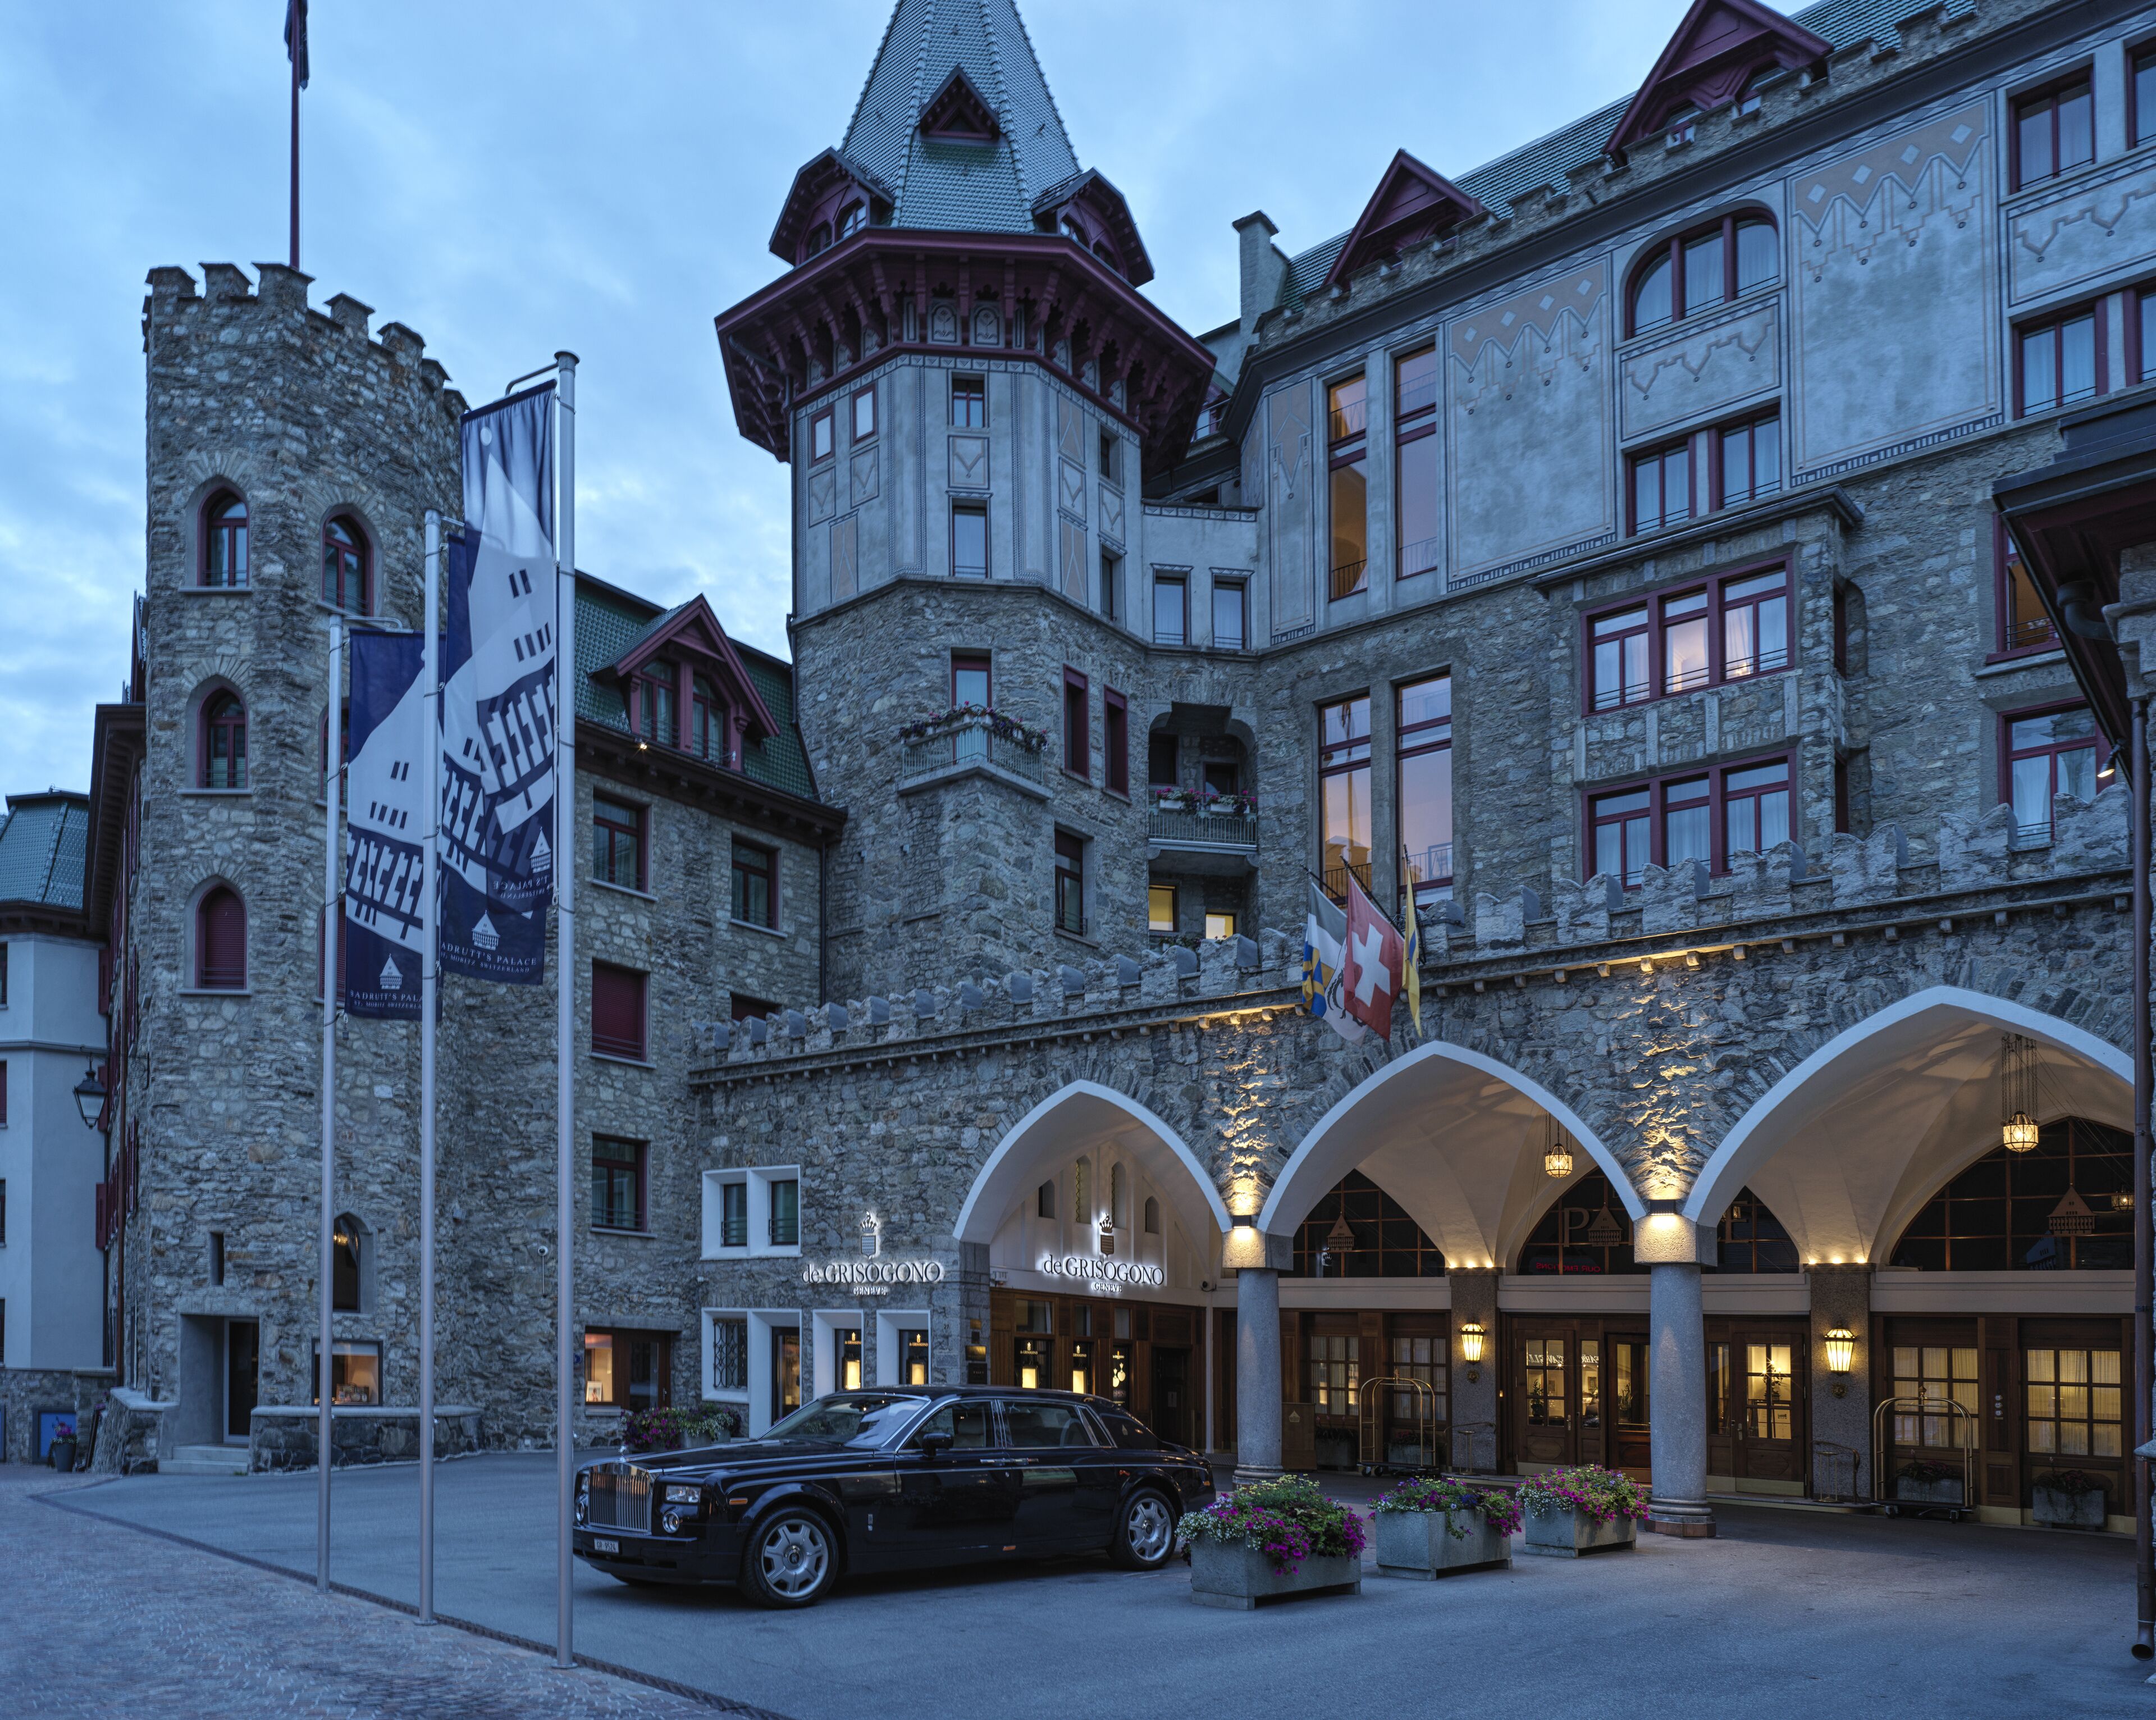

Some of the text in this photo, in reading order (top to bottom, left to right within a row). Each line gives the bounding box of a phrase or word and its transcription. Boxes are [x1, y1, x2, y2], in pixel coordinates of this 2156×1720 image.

[441, 942, 537, 966] ADRUTT'S PALACE
[450, 955, 476, 966] MORITZ
[480, 961, 530, 973] SWITZERLAND
[350, 989, 423, 1002] BADRUTT'S PALA
[802, 1261, 941, 1283] de GRISOGONO
[1044, 1254, 1164, 1285] de GRISOGONO
